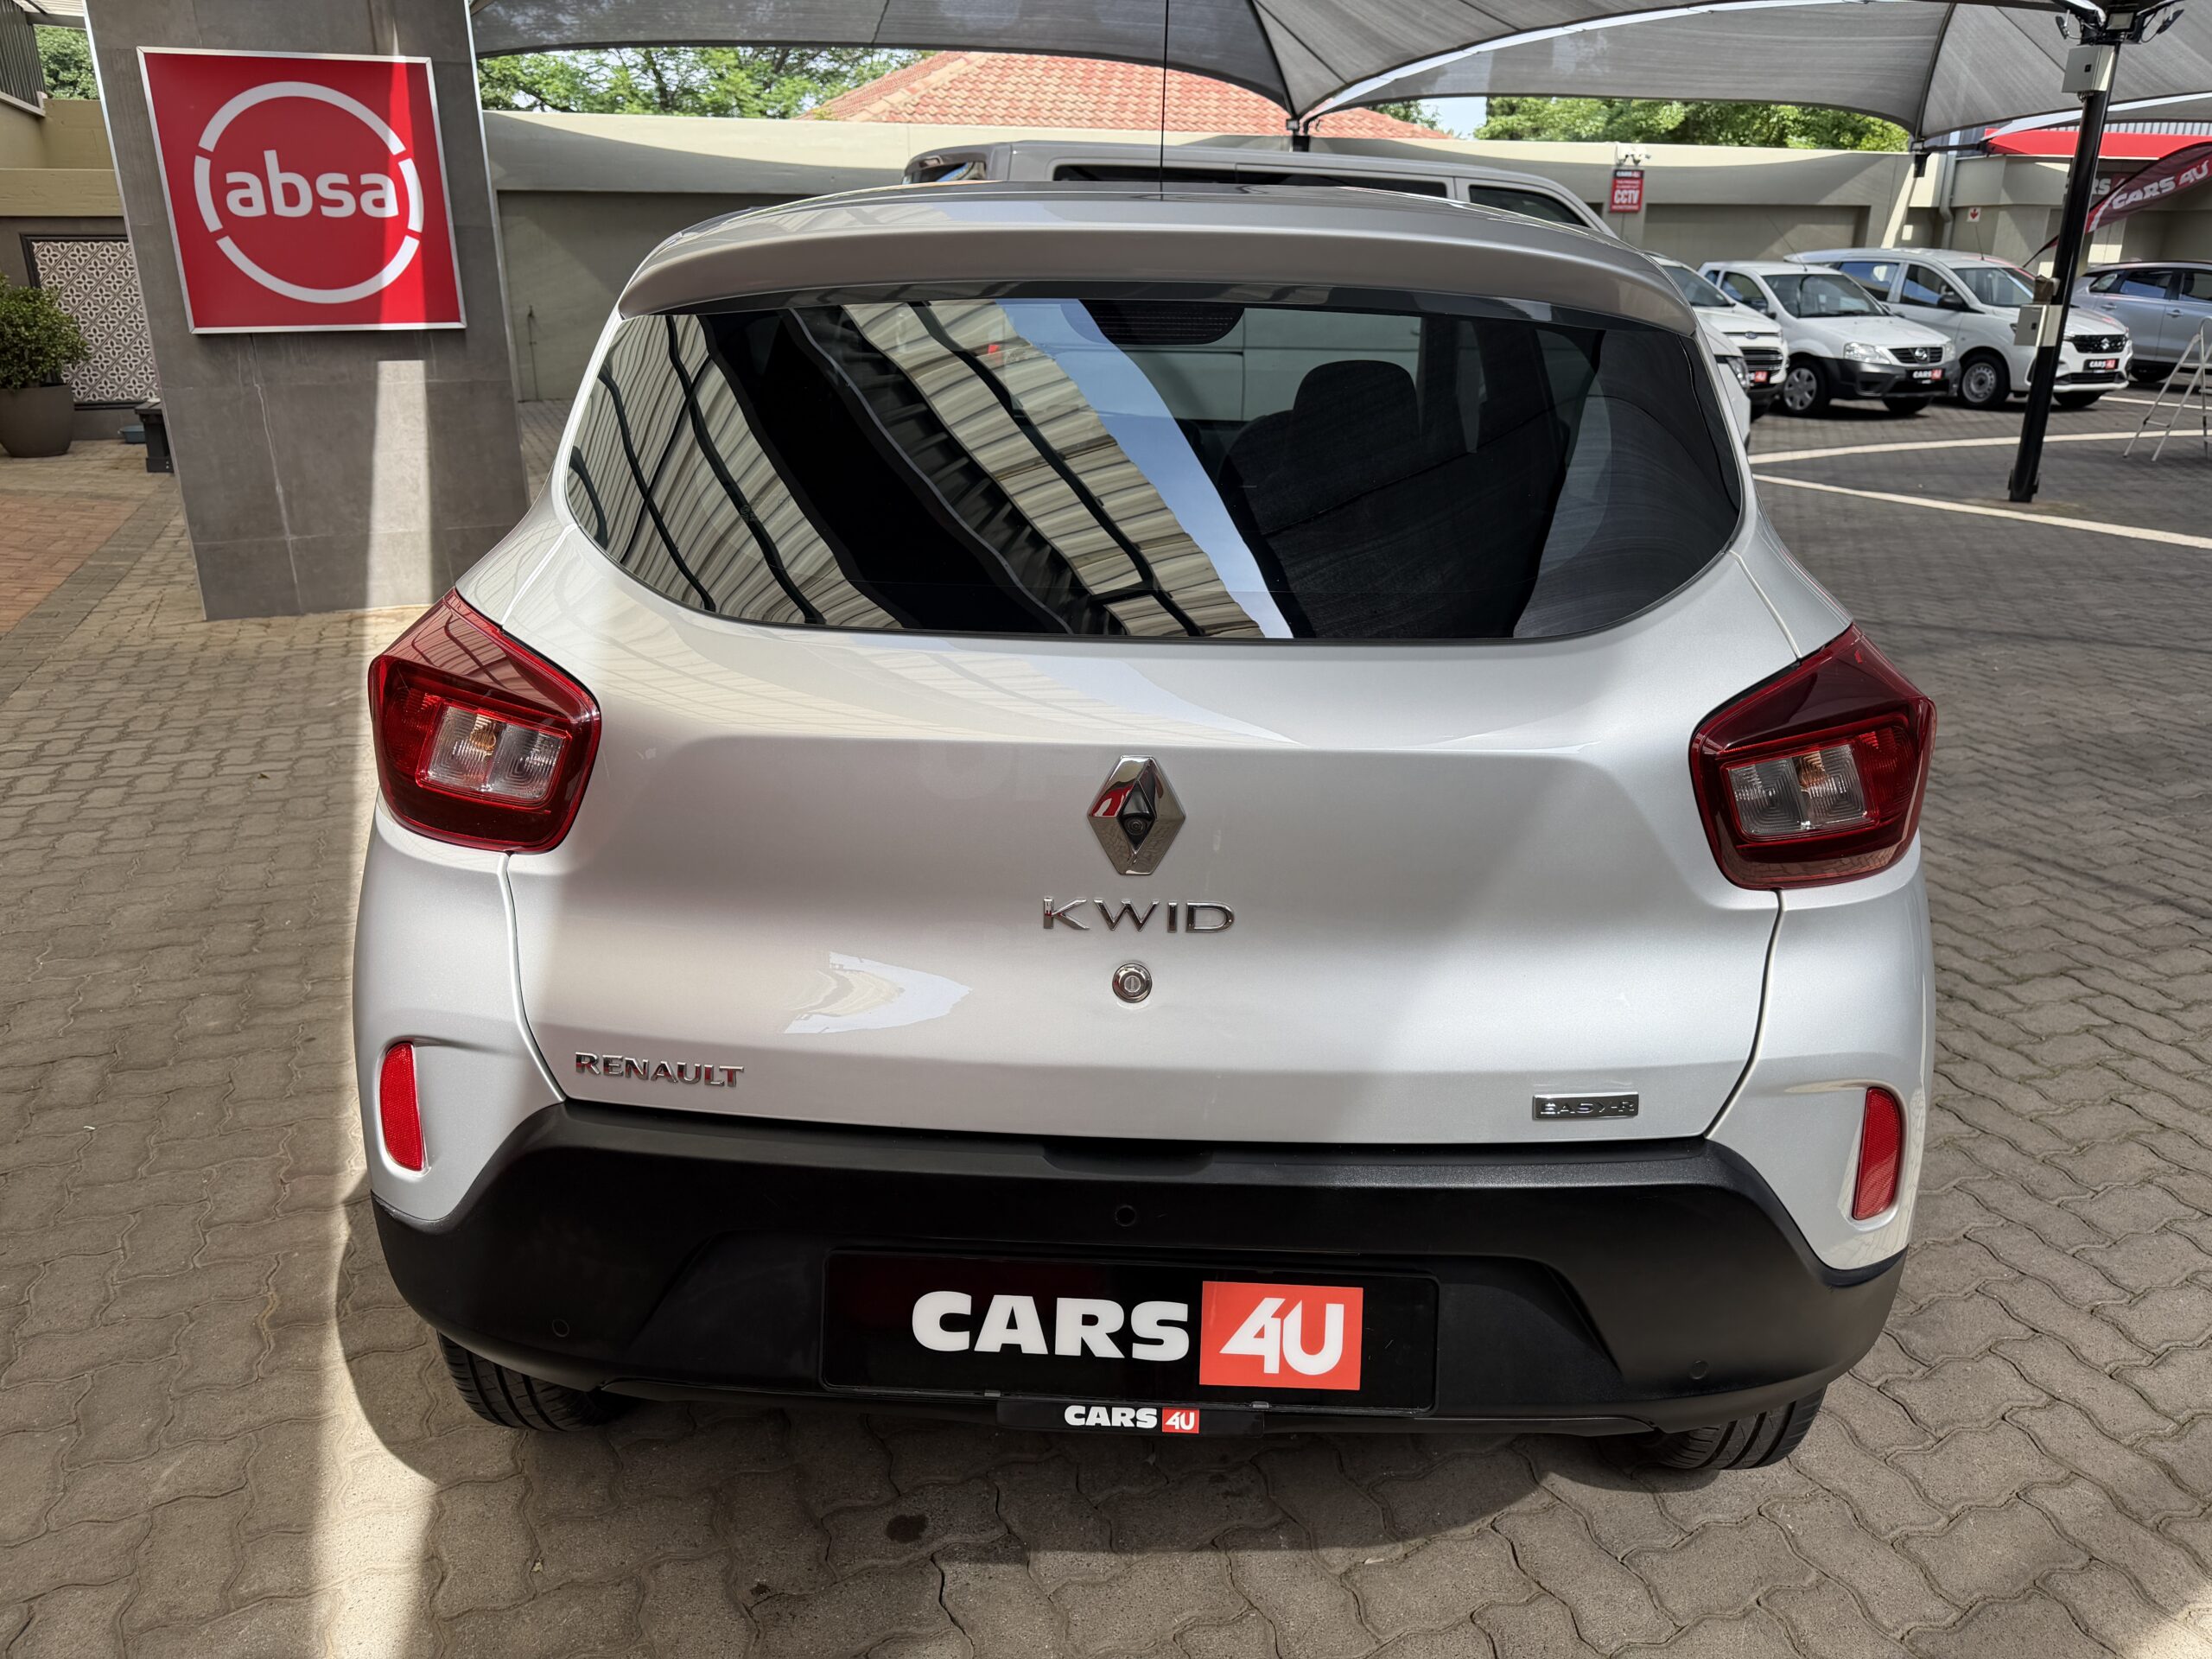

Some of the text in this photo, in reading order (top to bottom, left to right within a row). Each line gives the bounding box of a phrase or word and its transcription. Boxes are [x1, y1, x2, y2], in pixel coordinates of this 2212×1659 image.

[226, 149, 399, 218] absa
[1614, 189, 1640, 204] CCTV
[2112, 175, 2177, 209] CARS
[2178, 160, 2209, 185] 4U
[1042, 896, 1236, 933] KWID
[575, 1052, 745, 1087] RENAULT
[912, 1291, 1344, 1376] CARS 4U
[1065, 1405, 1195, 1430] CARS 4U
